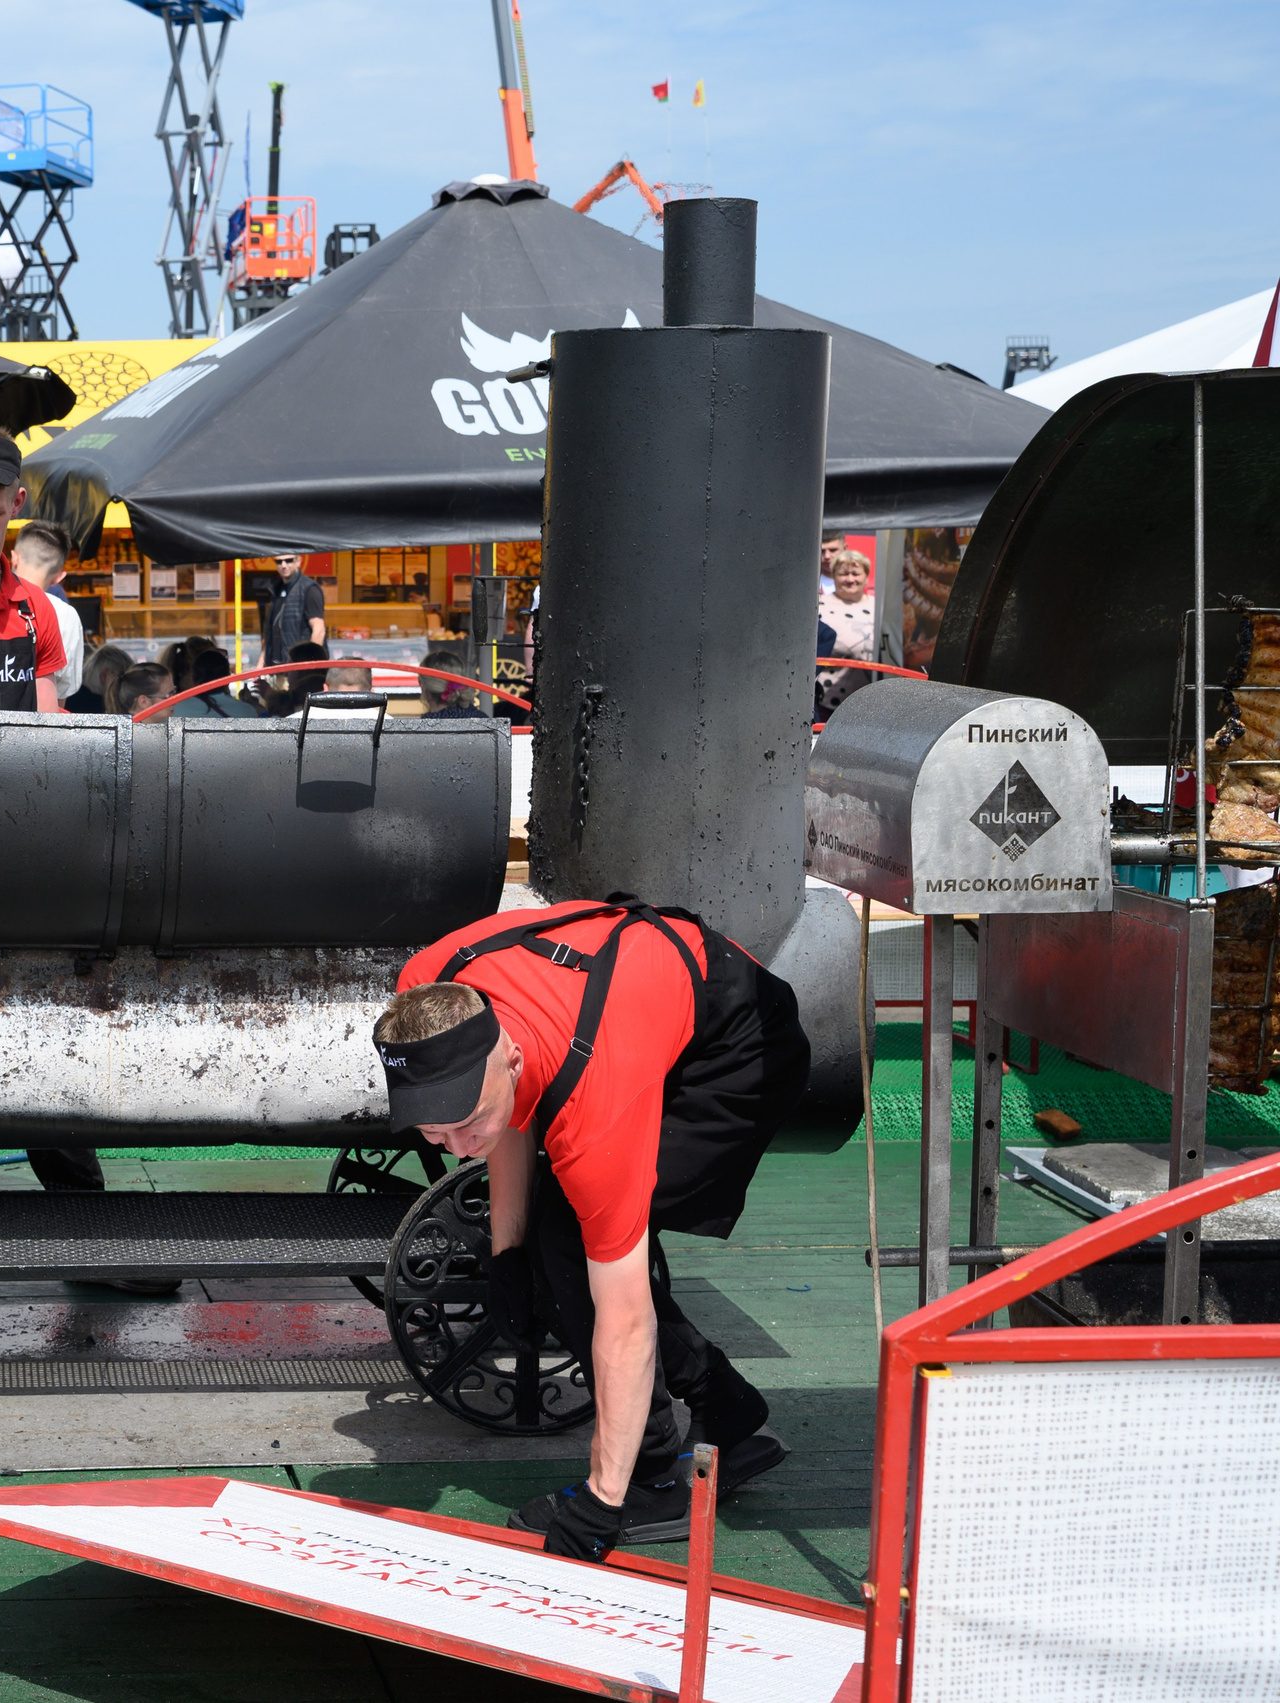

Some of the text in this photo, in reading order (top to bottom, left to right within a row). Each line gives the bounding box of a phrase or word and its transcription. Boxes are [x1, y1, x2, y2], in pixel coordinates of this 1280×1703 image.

[968, 722, 1068, 743] Пинский
[925, 873, 1099, 892] мясокомбинат
[463, 1567, 728, 1631] МЯСОКОМБИНТ
